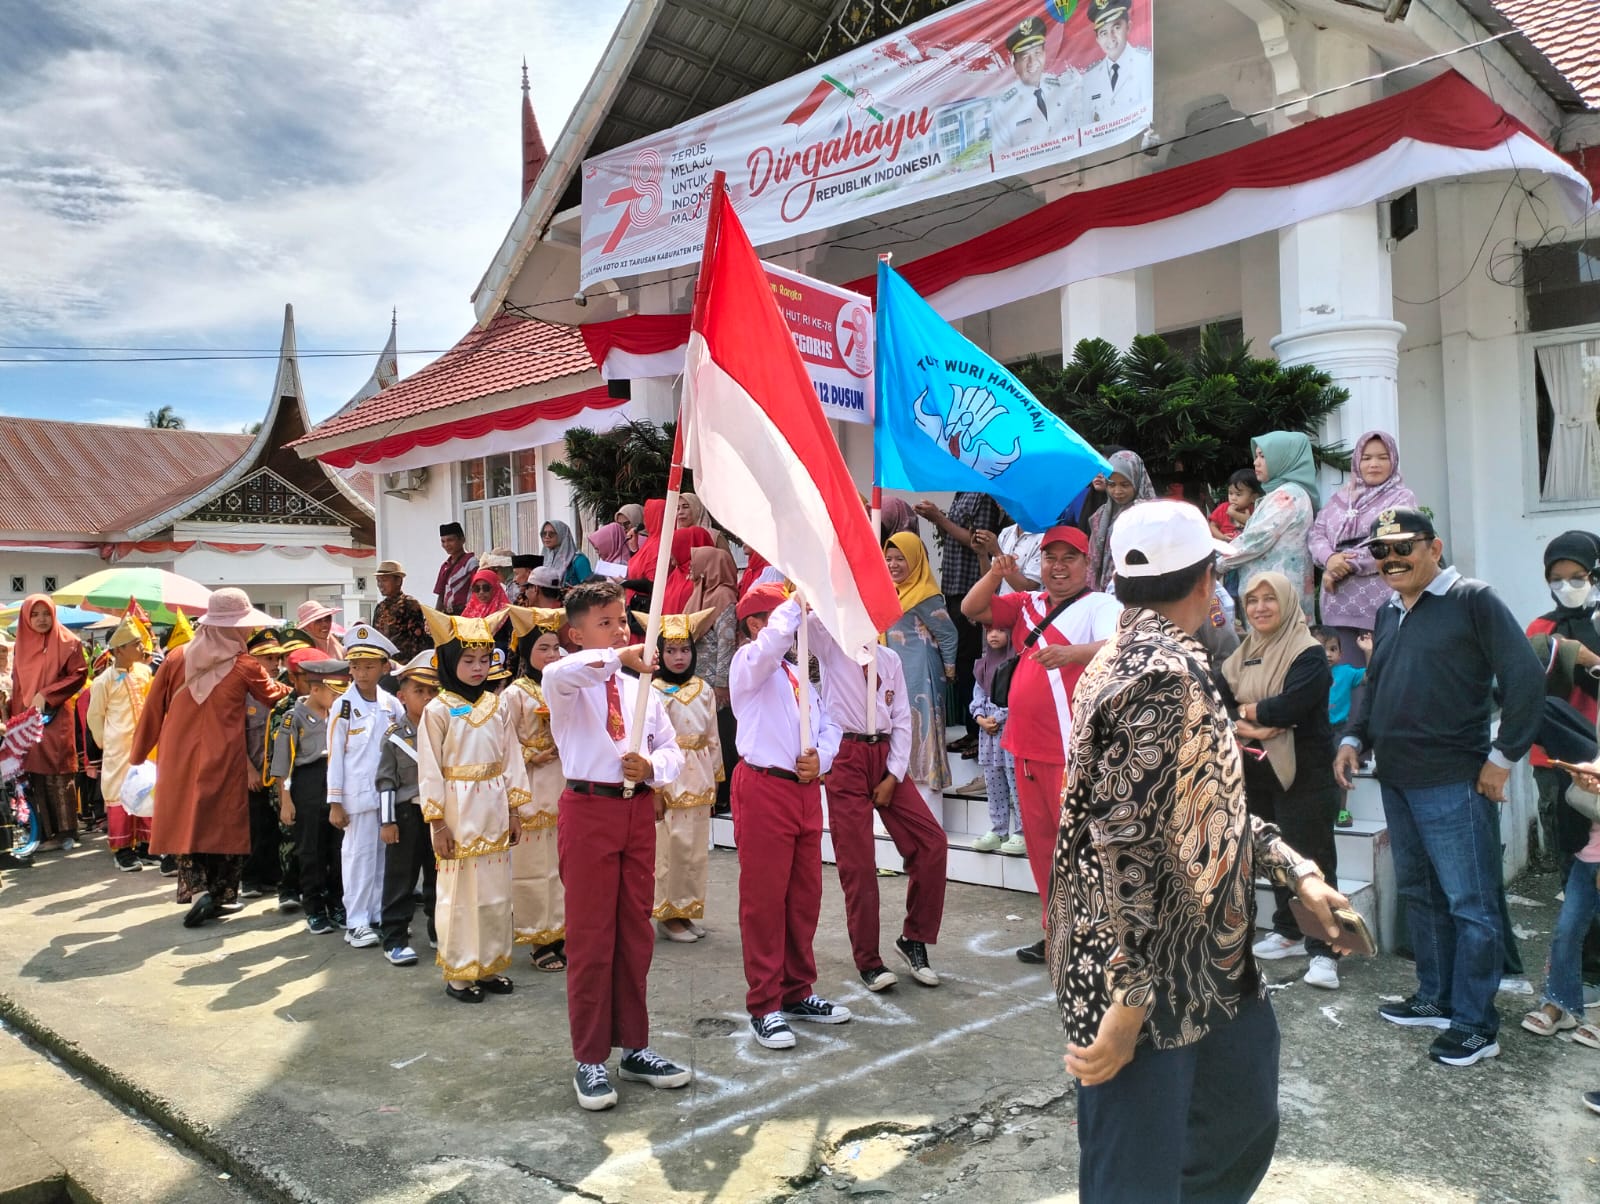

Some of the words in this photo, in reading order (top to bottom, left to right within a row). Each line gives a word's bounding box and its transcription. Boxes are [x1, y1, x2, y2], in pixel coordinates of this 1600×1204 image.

[671, 142, 707, 162] TERUS
[746, 106, 935, 223] Dirgahayu
[671, 154, 714, 180] MELAJU
[816, 173, 872, 202] REPUBLIK
[874, 152, 942, 184] INDONESIA
[672, 172, 708, 195] UNTUK
[672, 182, 731, 211] INDONEA
[601, 147, 663, 255] 78
[671, 207, 703, 226] MAJU
[657, 245, 692, 262] KABUPATEN
[785, 308, 801, 322] HUT
[802, 313, 811, 326] RI
[811, 317, 833, 333] KE-78
[917, 355, 940, 372] TUT
[944, 359, 985, 381] WURI
[819, 382, 829, 404] 12
[831, 384, 865, 411] DUSUN
